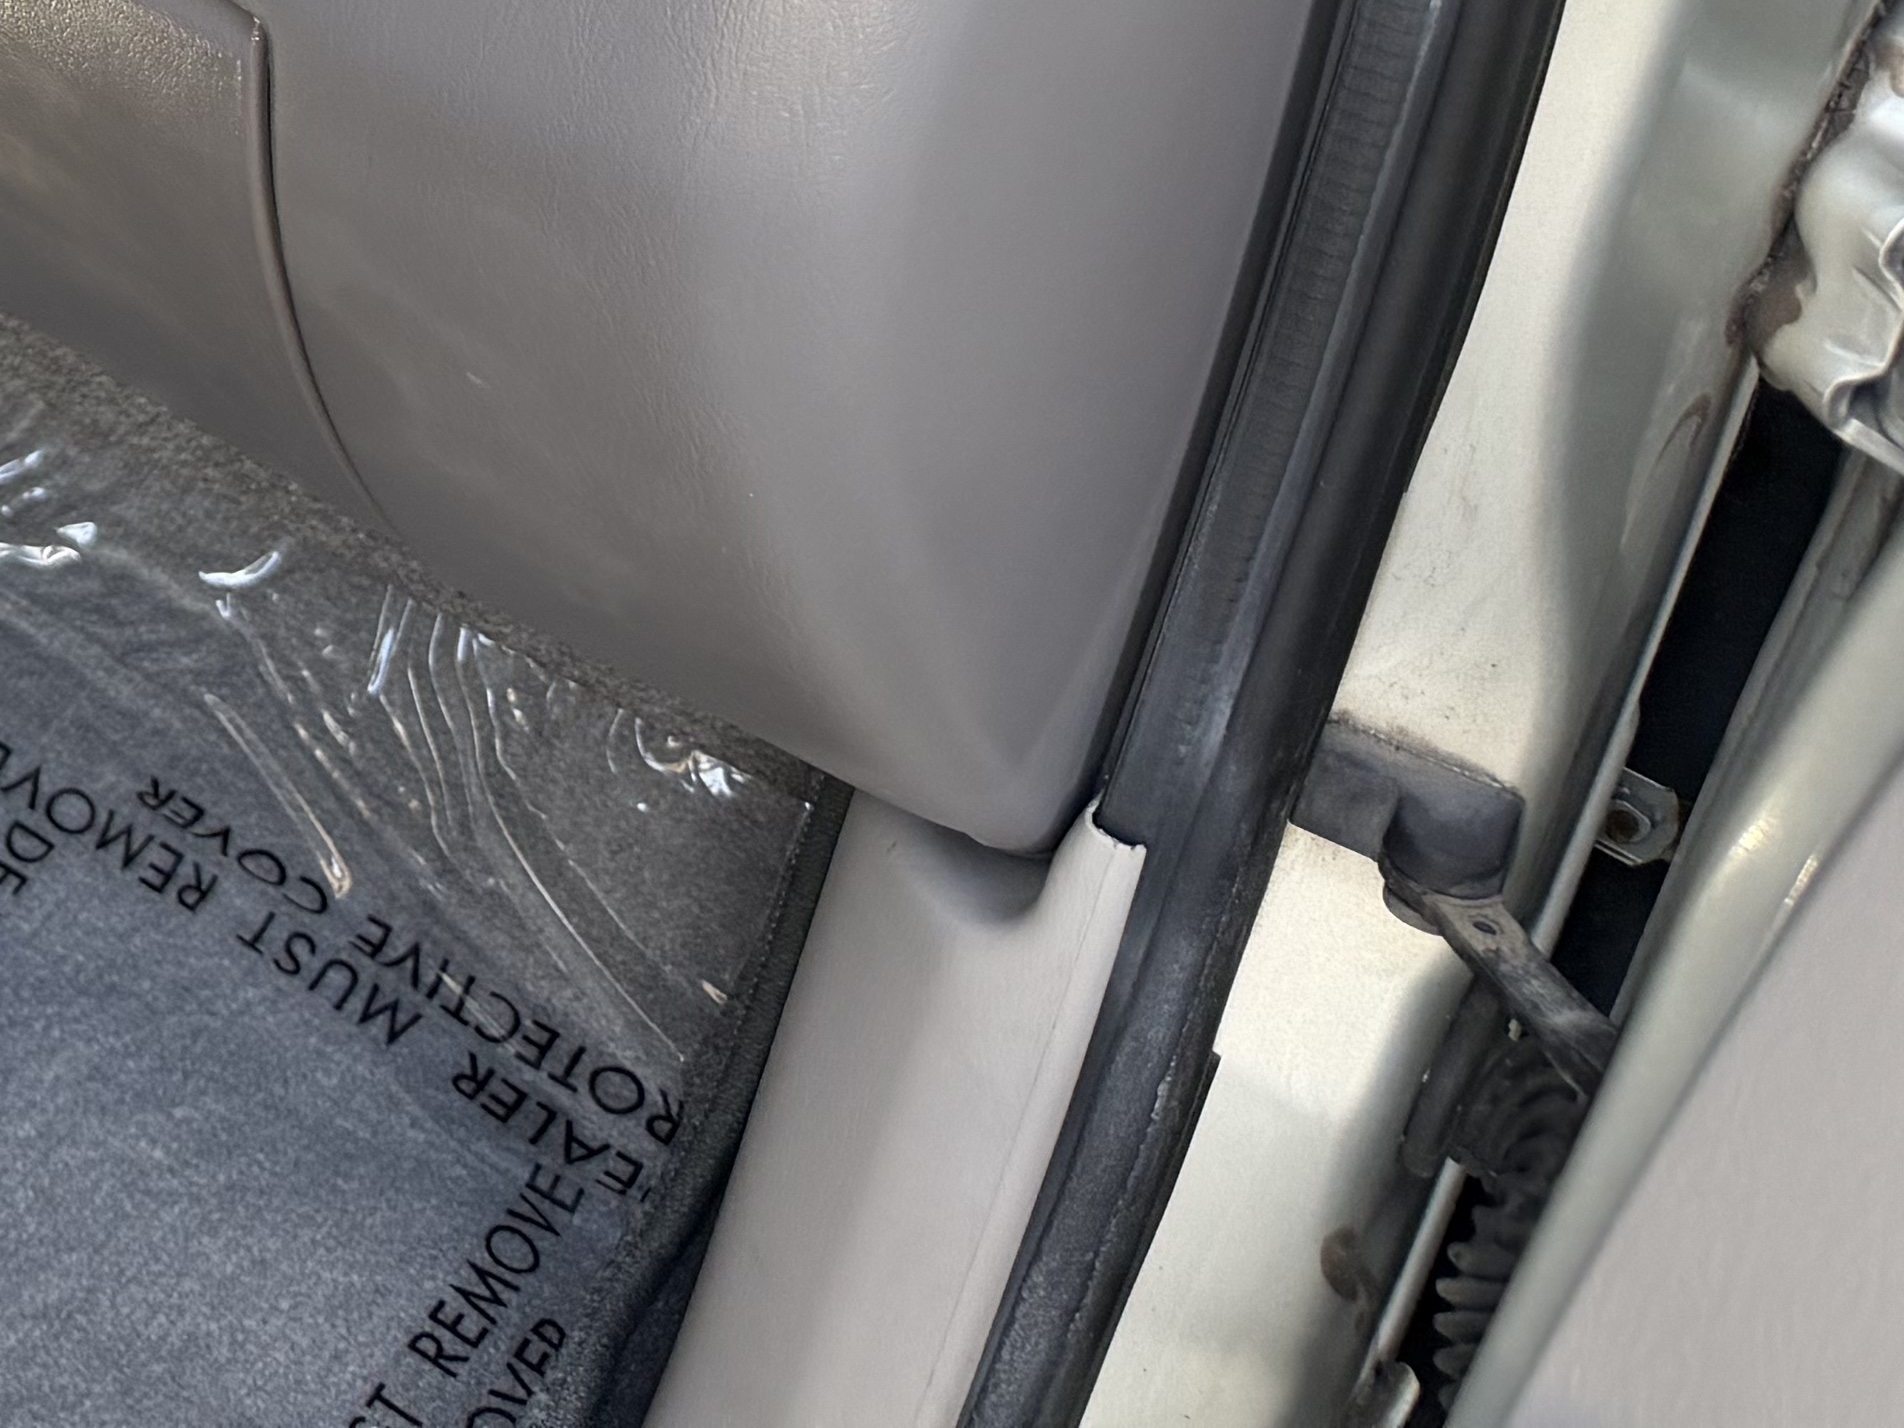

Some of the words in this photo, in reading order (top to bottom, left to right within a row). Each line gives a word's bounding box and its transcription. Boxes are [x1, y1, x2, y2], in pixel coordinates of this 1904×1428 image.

[134, 774, 330, 917] COVER
[236, 910, 425, 1047] MUST
[349, 914, 685, 1146] ROTECTIVE
[450, 1050, 652, 1203] EALER
[406, 1162, 586, 1380] REMOVE
